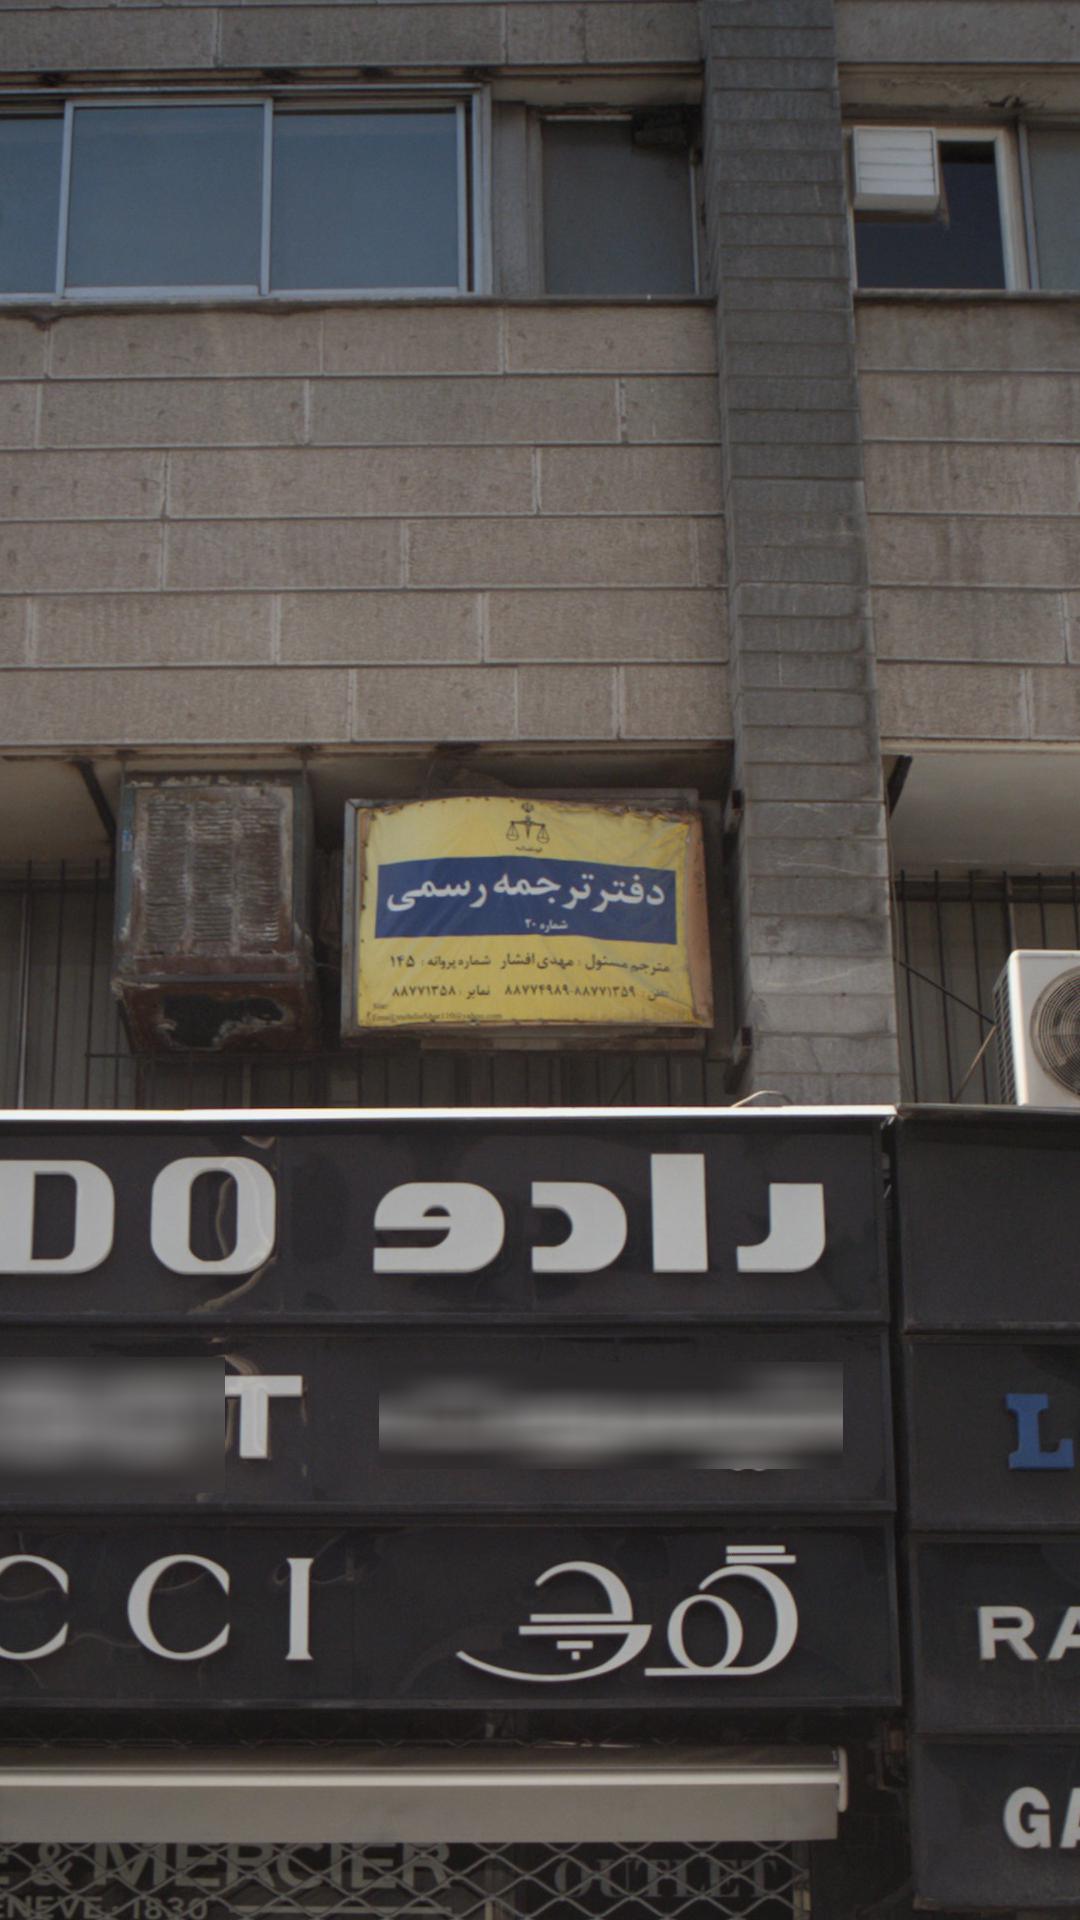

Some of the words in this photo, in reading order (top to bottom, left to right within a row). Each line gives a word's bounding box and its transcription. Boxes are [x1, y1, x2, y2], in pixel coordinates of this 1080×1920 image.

[386, 880, 488, 912] رسمی
[493, 872, 595, 910] ترجمه
[591, 874, 665, 913] دفتر
[540, 919, 569, 933] شماره
[390, 955, 416, 968] ۱۴۵
[428, 955, 457, 970] پروانه
[457, 955, 492, 969] شماره
[501, 953, 536, 969] افشار
[537, 956, 575, 970] مهدی
[630, 962, 671, 975] مترجم
[0, 1156, 276, 1275] DO
[373, 1153, 826, 1274] رادو
[94, 1842, 452, 1890] MERCIER
[553, 1858, 778, 1898] OUTLET
